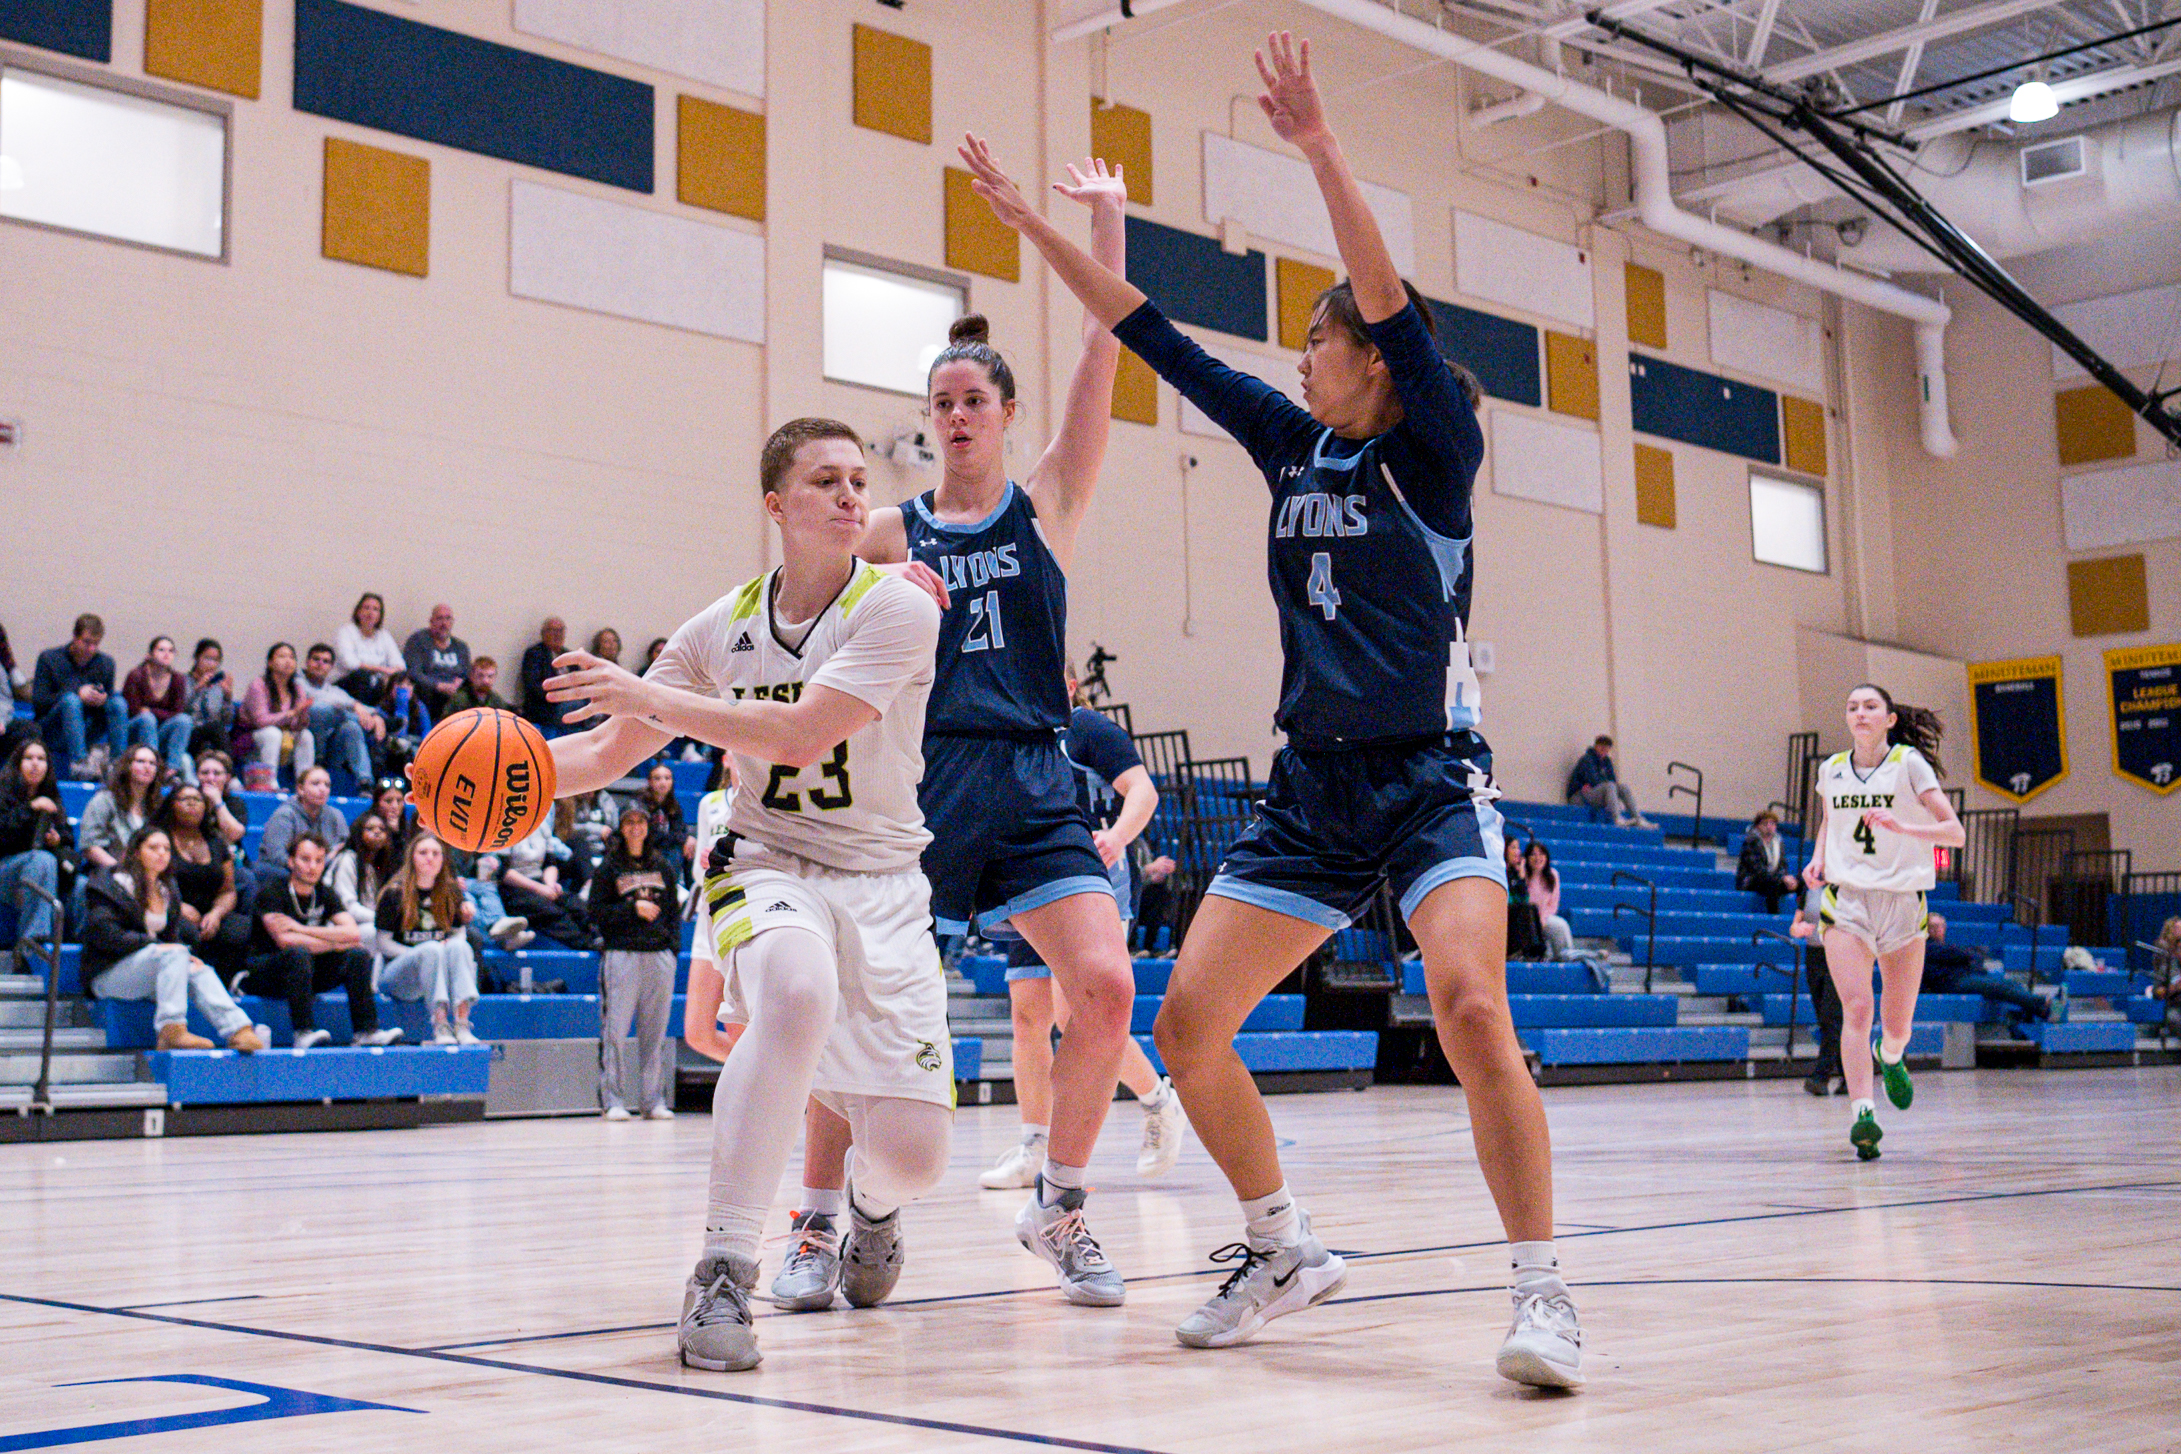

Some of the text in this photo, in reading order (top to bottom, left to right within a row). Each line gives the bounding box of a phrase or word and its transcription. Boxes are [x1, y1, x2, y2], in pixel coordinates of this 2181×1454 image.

[1276, 493, 1368, 538] LYONS
[940, 542, 1020, 591] LYONS
[1307, 552, 1342, 620] 4
[962, 590, 1005, 653] 21
[762, 739, 853, 812] 23
[1832, 794, 1895, 809] LESLEY
[489, 760, 530, 848] Wilson
[1853, 815, 1876, 854] 4
